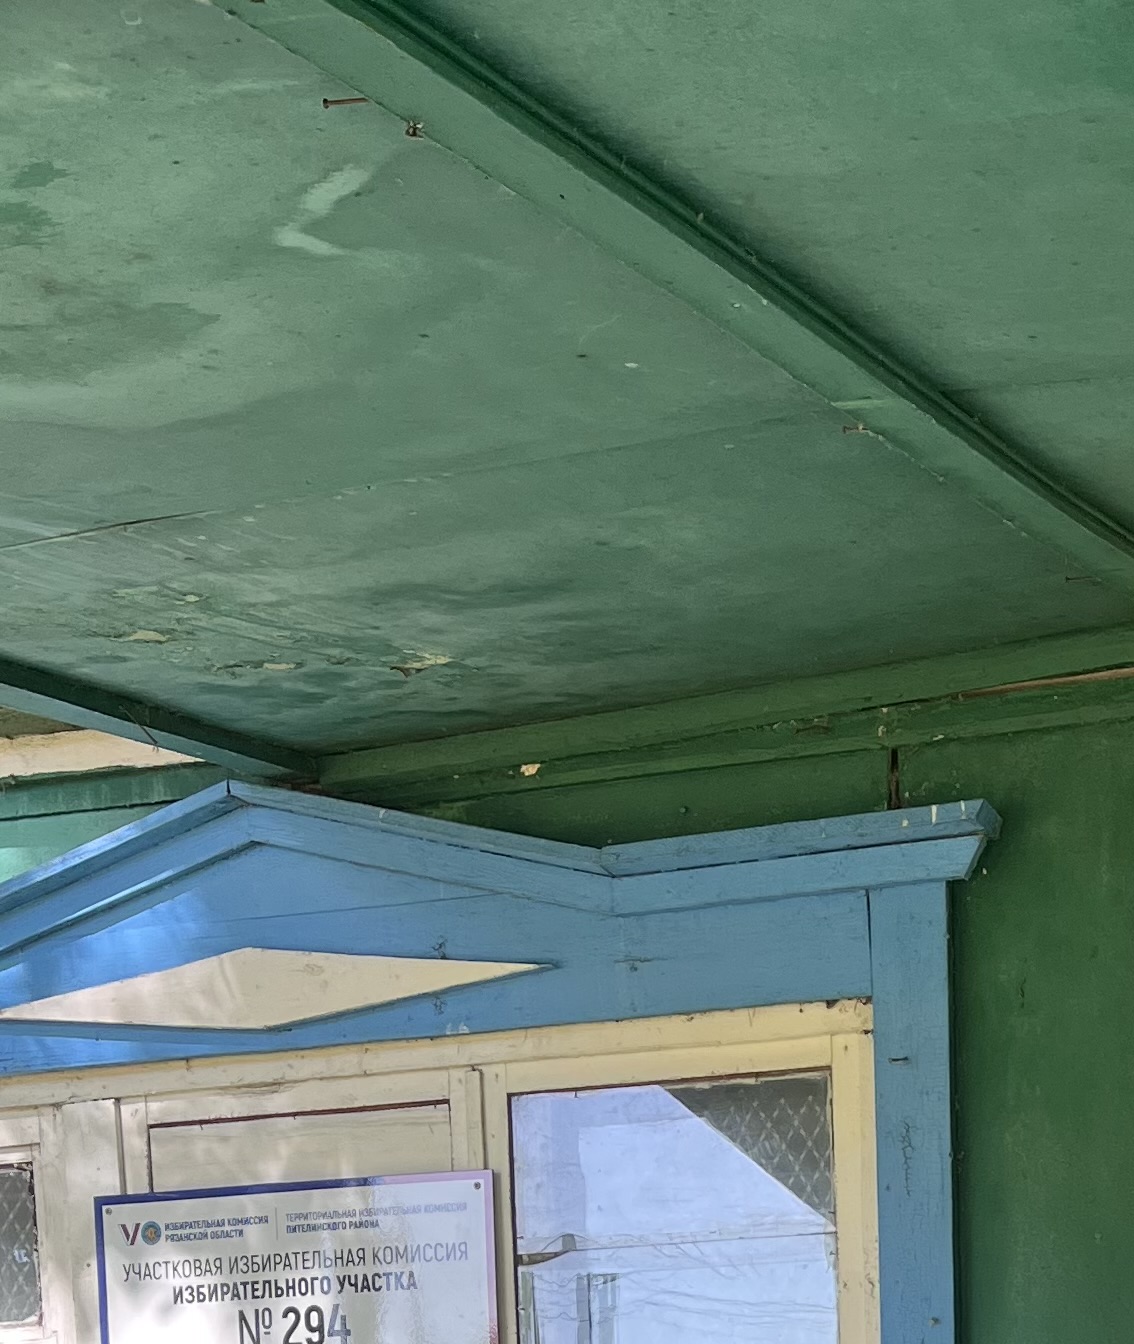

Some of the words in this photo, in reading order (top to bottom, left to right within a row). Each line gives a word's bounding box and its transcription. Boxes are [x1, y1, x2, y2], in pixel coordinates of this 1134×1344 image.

[286, 1208, 357, 1223] ТЕРРИТОРИАЛЬНАЯ
[359, 1204, 422, 1219] ИЗБИРАТЕЛЬНАЯ
[424, 1202, 468, 1214] КОМИССИЯ
[164, 1217, 226, 1232] ИЗБИРАТЕЛЬНАЯ
[227, 1215, 269, 1227] КОМИССИЯ
[348, 1218, 380, 1230] РАЙОНА
[164, 1231, 209, 1243] РЯЗАНСКОЙ
[210, 1228, 244, 1240] ОБЛАСТИ
[122, 1257, 223, 1283] УЧАСТКОВАЯ
[228, 1247, 366, 1275] ИЗБИРАТЕЛЬНАЯ
[372, 1241, 469, 1266] КОМИССИЯ
[172, 1275, 332, 1305] ИЗБИРАТЕЛЬНОГО
[336, 1270, 418, 1294] УЧАСТКА
